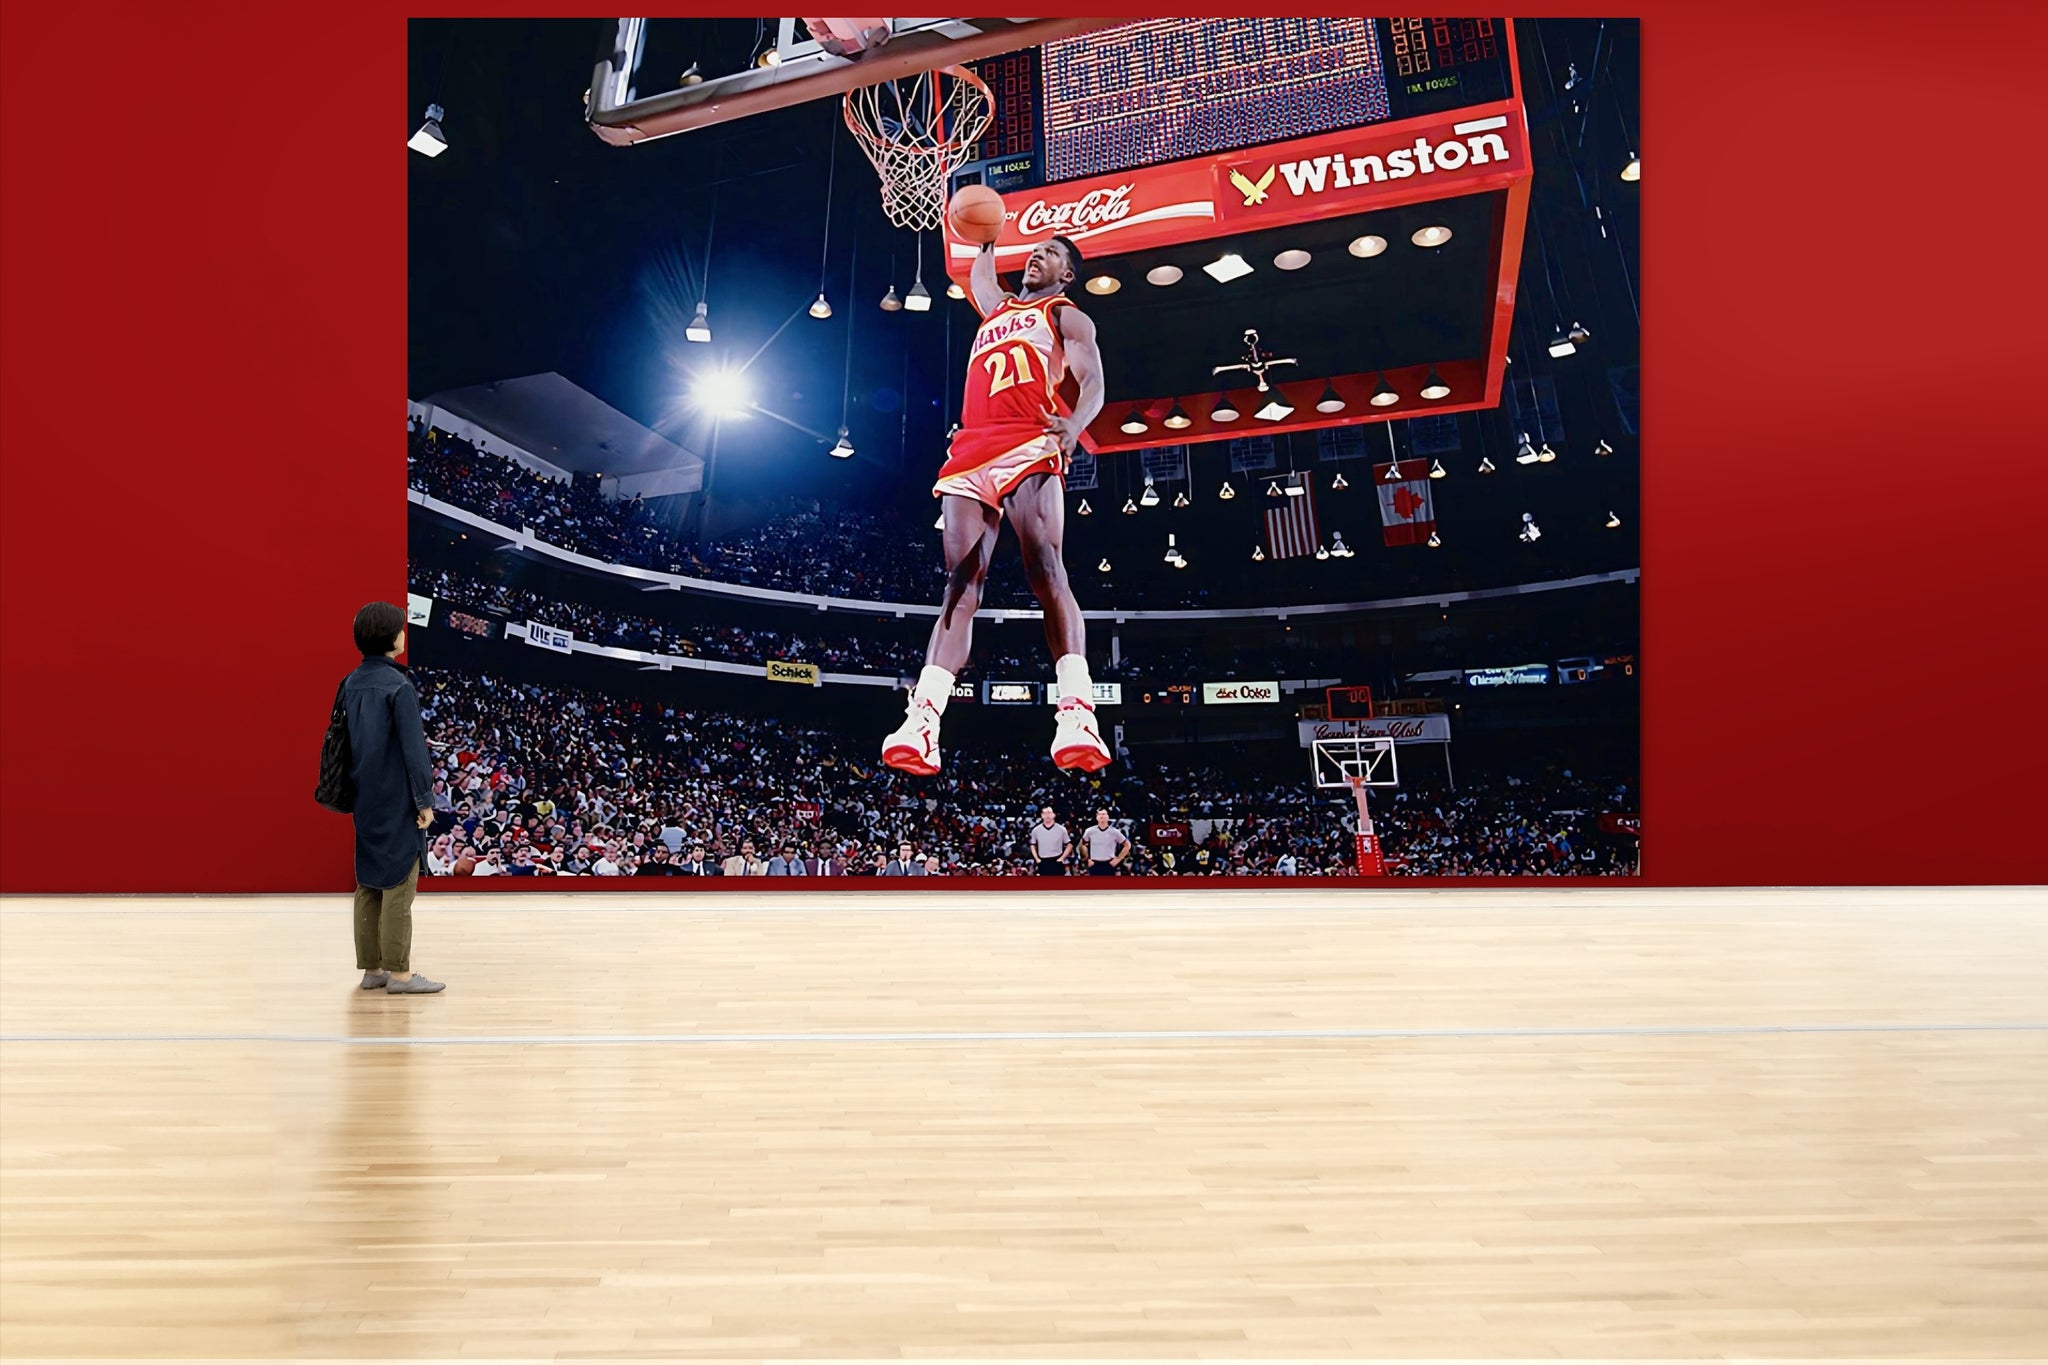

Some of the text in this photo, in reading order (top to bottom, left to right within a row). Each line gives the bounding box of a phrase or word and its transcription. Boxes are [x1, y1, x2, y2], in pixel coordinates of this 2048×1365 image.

[1279, 132, 1510, 196] Winston
[1018, 183, 1135, 235] Coca-Cola
[983, 345, 1034, 397] 21
[771, 664, 812, 679] Schick
[1240, 685, 1271, 699] Coke
